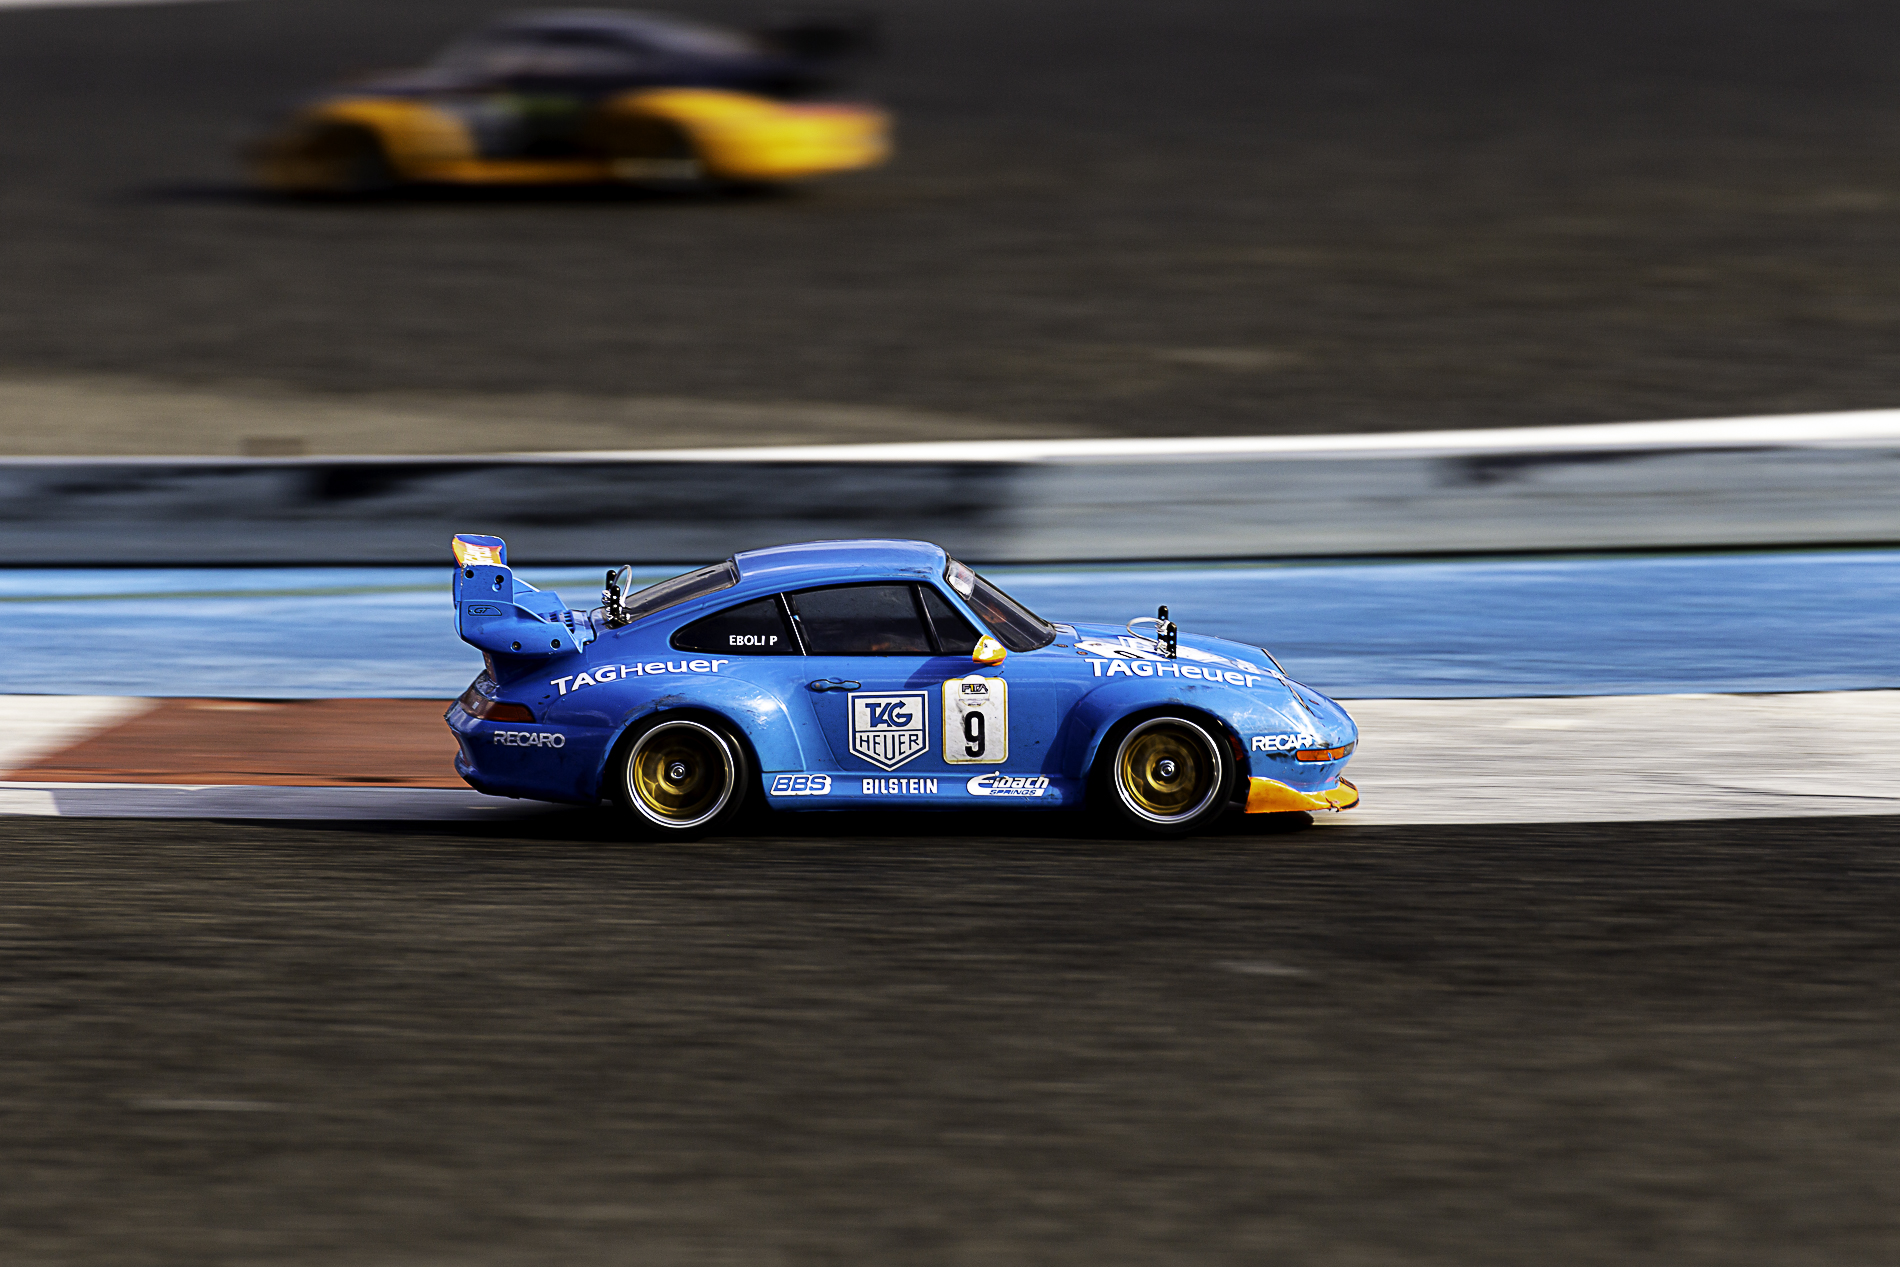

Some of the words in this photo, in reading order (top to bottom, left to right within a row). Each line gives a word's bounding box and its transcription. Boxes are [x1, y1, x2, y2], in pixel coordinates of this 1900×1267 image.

[729, 635, 765, 646] EBOLI
[769, 635, 778, 646] P
[865, 700, 913, 728] TAG
[493, 730, 566, 748] RECARO
[964, 710, 986, 758] 9
[1251, 734, 1316, 751] RECAR
[859, 733, 920, 761] HEUER
[771, 775, 829, 793] BBS
[862, 778, 938, 794] BILSTEIN
